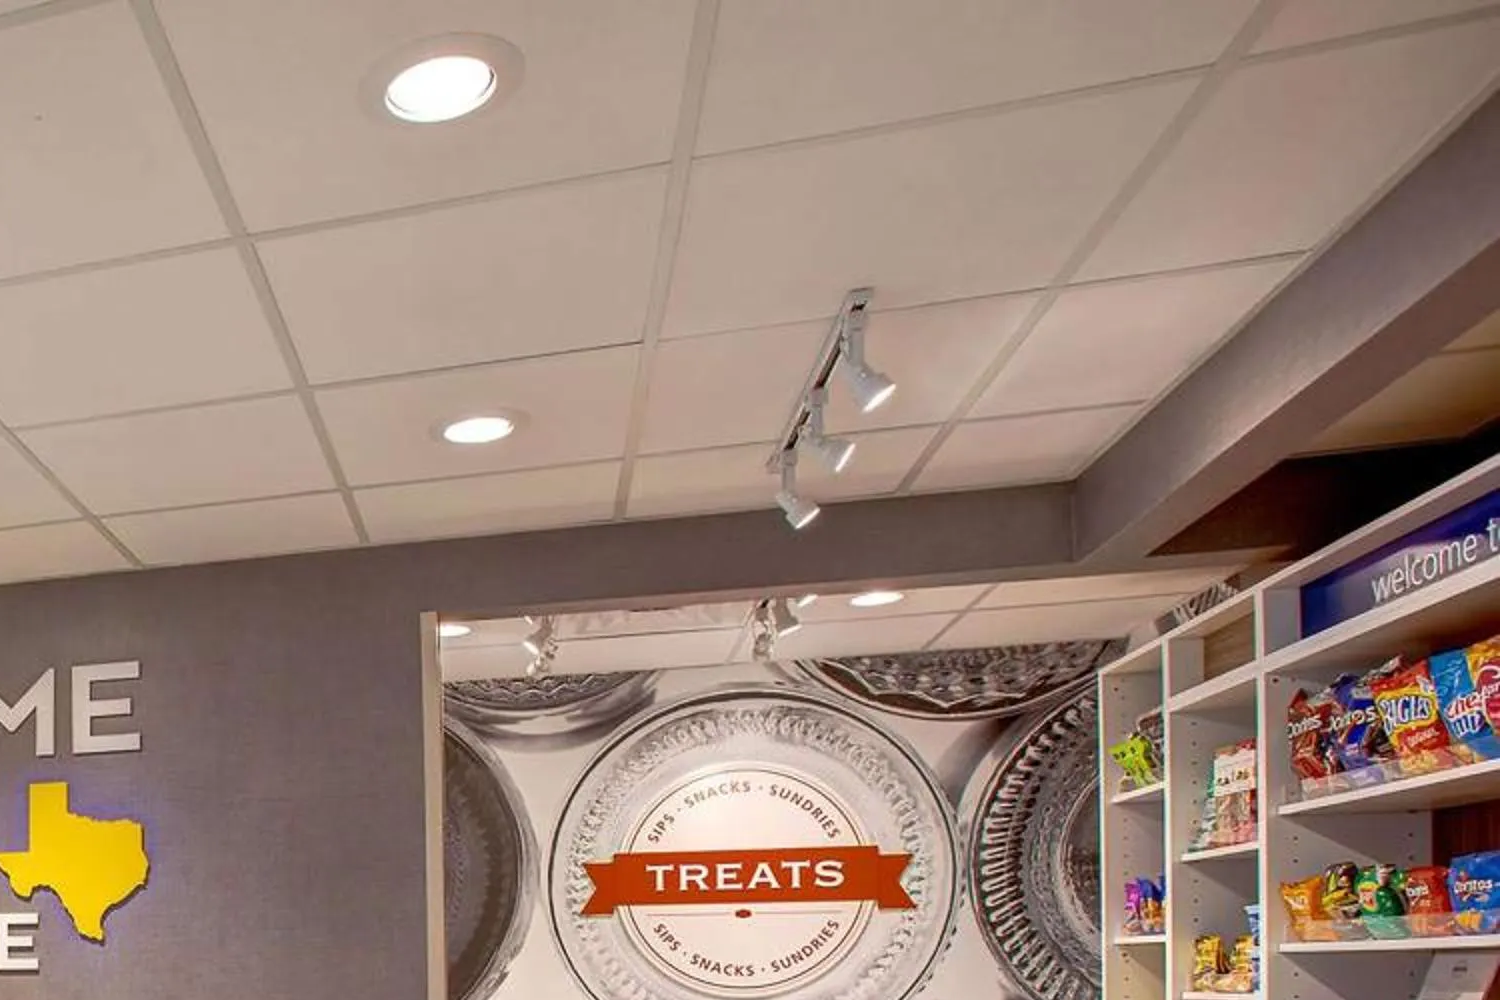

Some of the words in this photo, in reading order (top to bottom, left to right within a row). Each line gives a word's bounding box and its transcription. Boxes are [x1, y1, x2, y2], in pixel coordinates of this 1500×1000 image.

[1372, 534, 1477, 603] welcome
[1486, 517, 1500, 552] t
[647, 813, 675, 844] SIPS
[683, 781, 751, 809] SNACKS
[769, 784, 841, 839] SUNDRIES
[645, 860, 846, 892] TREATS
[653, 923, 683, 952] SIPS
[690, 954, 755, 977] SNACKS
[771, 920, 840, 973] SUNDRIES
